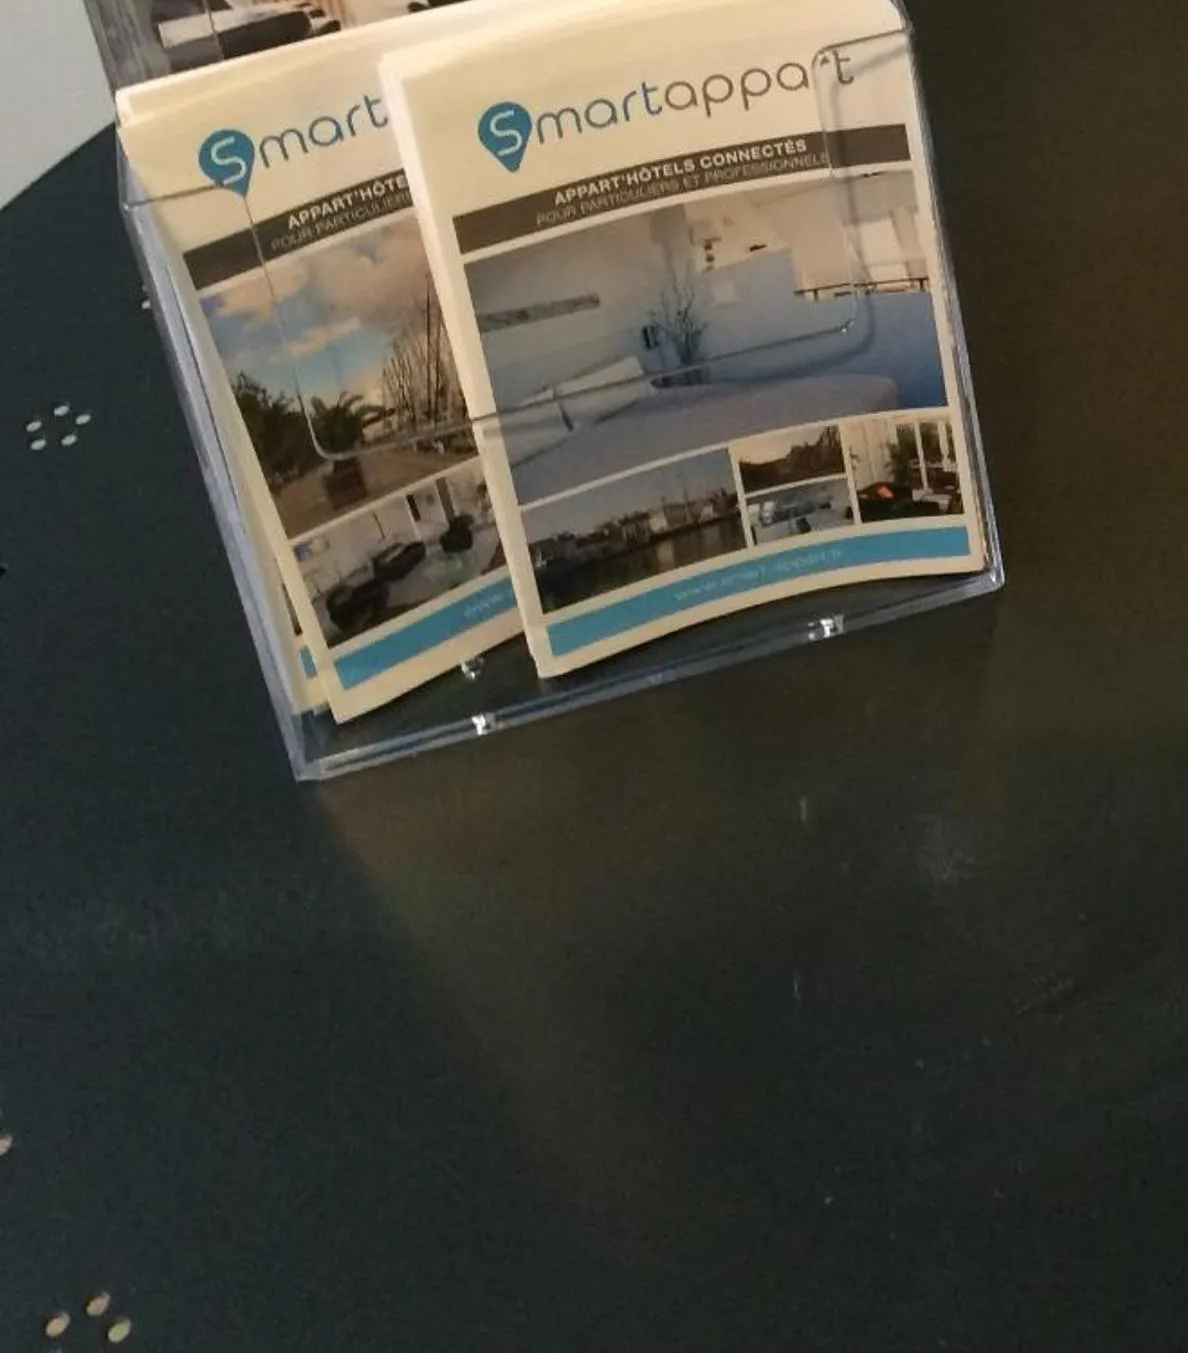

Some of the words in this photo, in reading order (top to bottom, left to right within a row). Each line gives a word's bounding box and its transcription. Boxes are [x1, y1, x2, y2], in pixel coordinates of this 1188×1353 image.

[208, 94, 390, 186] Smart
[554, 157, 696, 207] APPART'HÔTELS
[699, 137, 808, 169] CONNECTÉS
[288, 174, 409, 231] APPART'HÔTE
